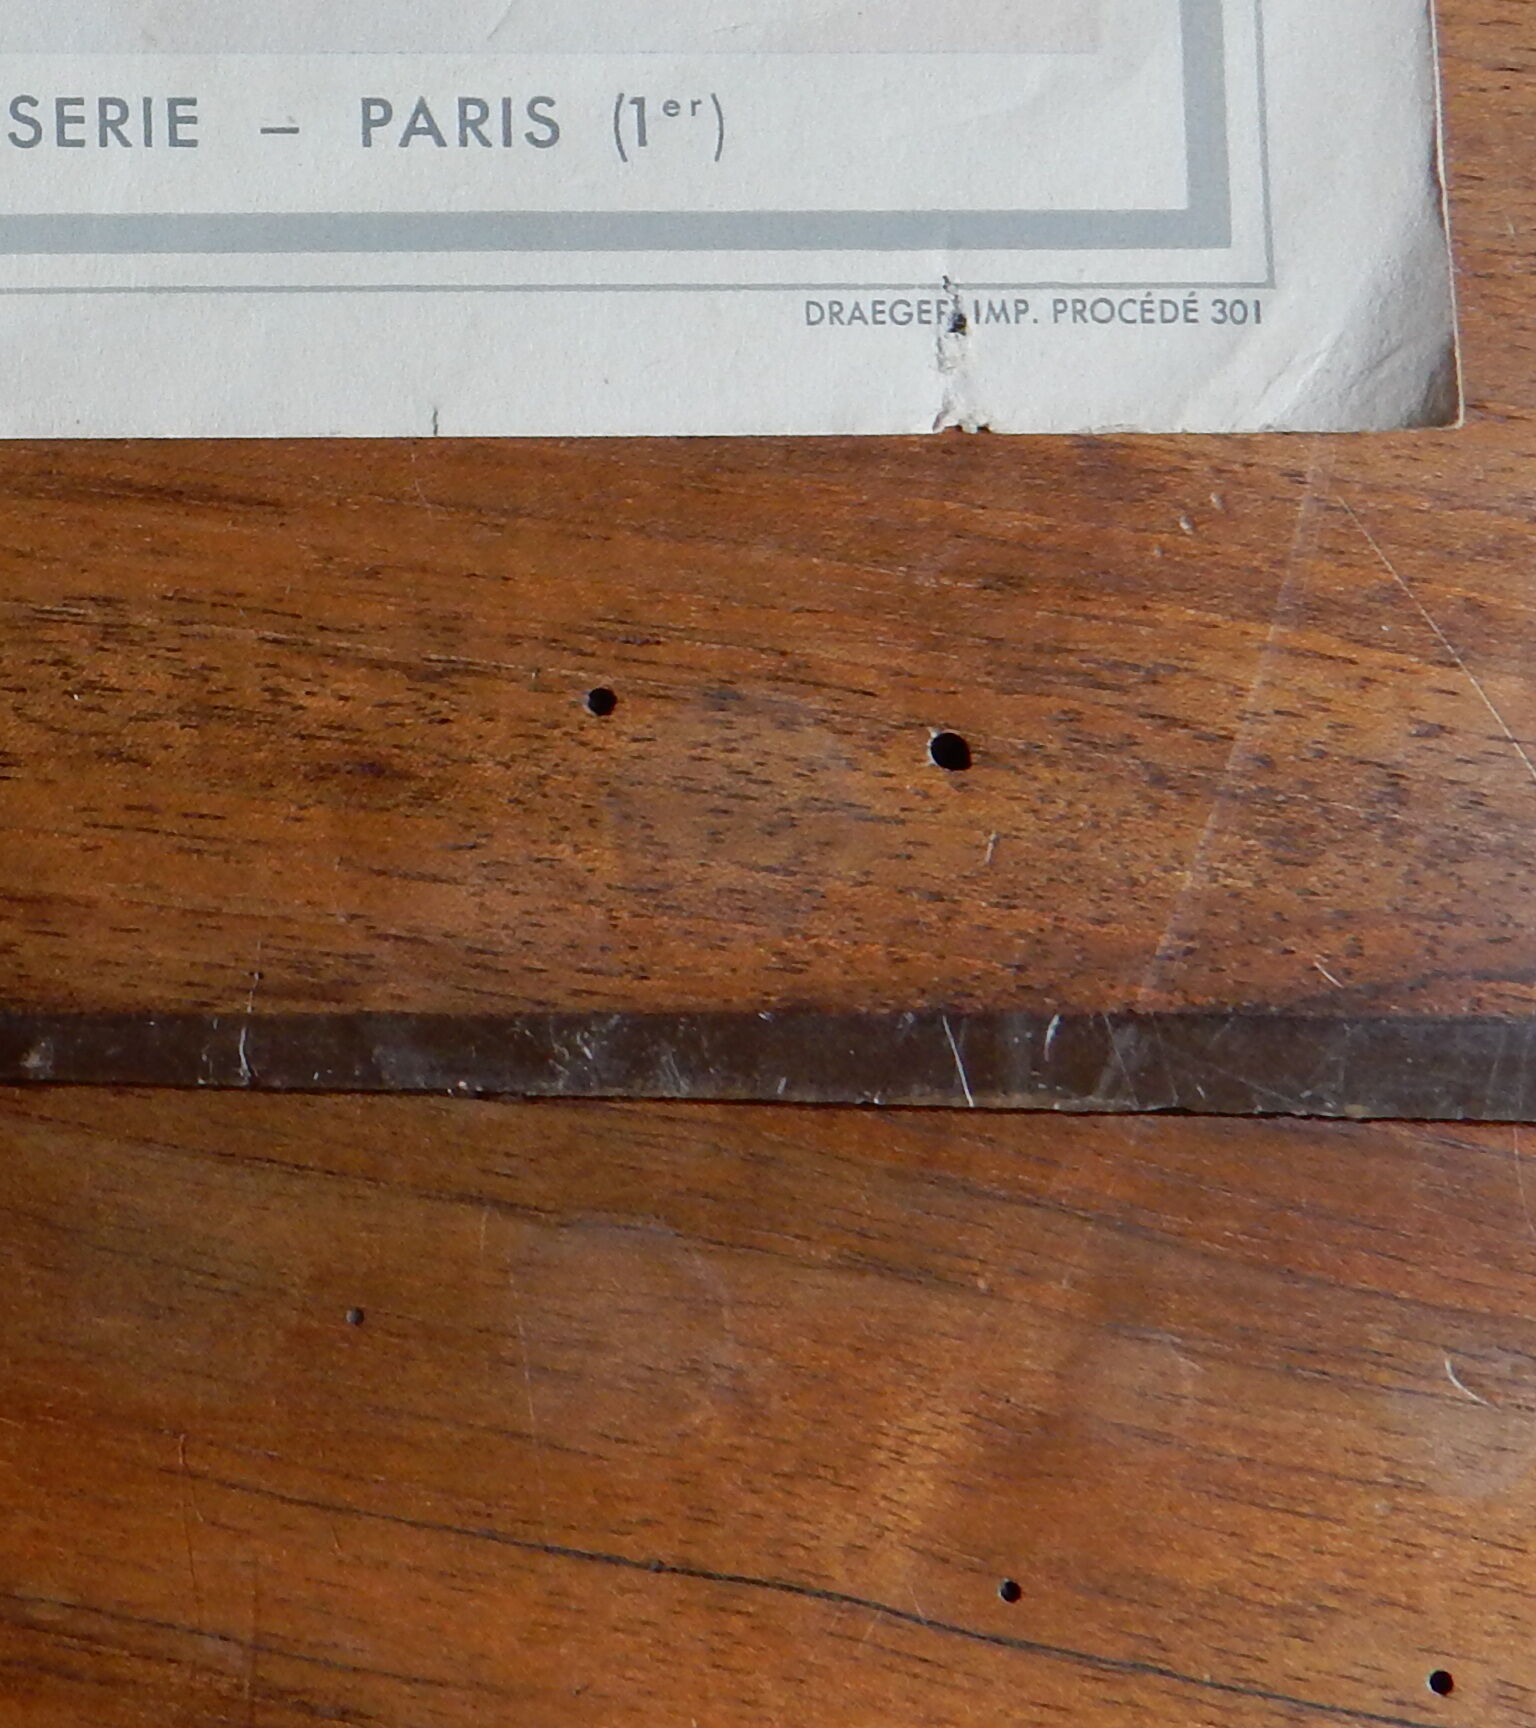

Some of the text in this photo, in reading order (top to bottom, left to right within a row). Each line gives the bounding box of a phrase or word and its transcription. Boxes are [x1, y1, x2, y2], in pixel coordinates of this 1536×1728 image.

[360, 95, 561, 149] PARIS
[973, 298, 1039, 325] IMP.
[1052, 291, 1200, 325] PROCÉDÉ
[1210, 298, 1263, 326] 301
